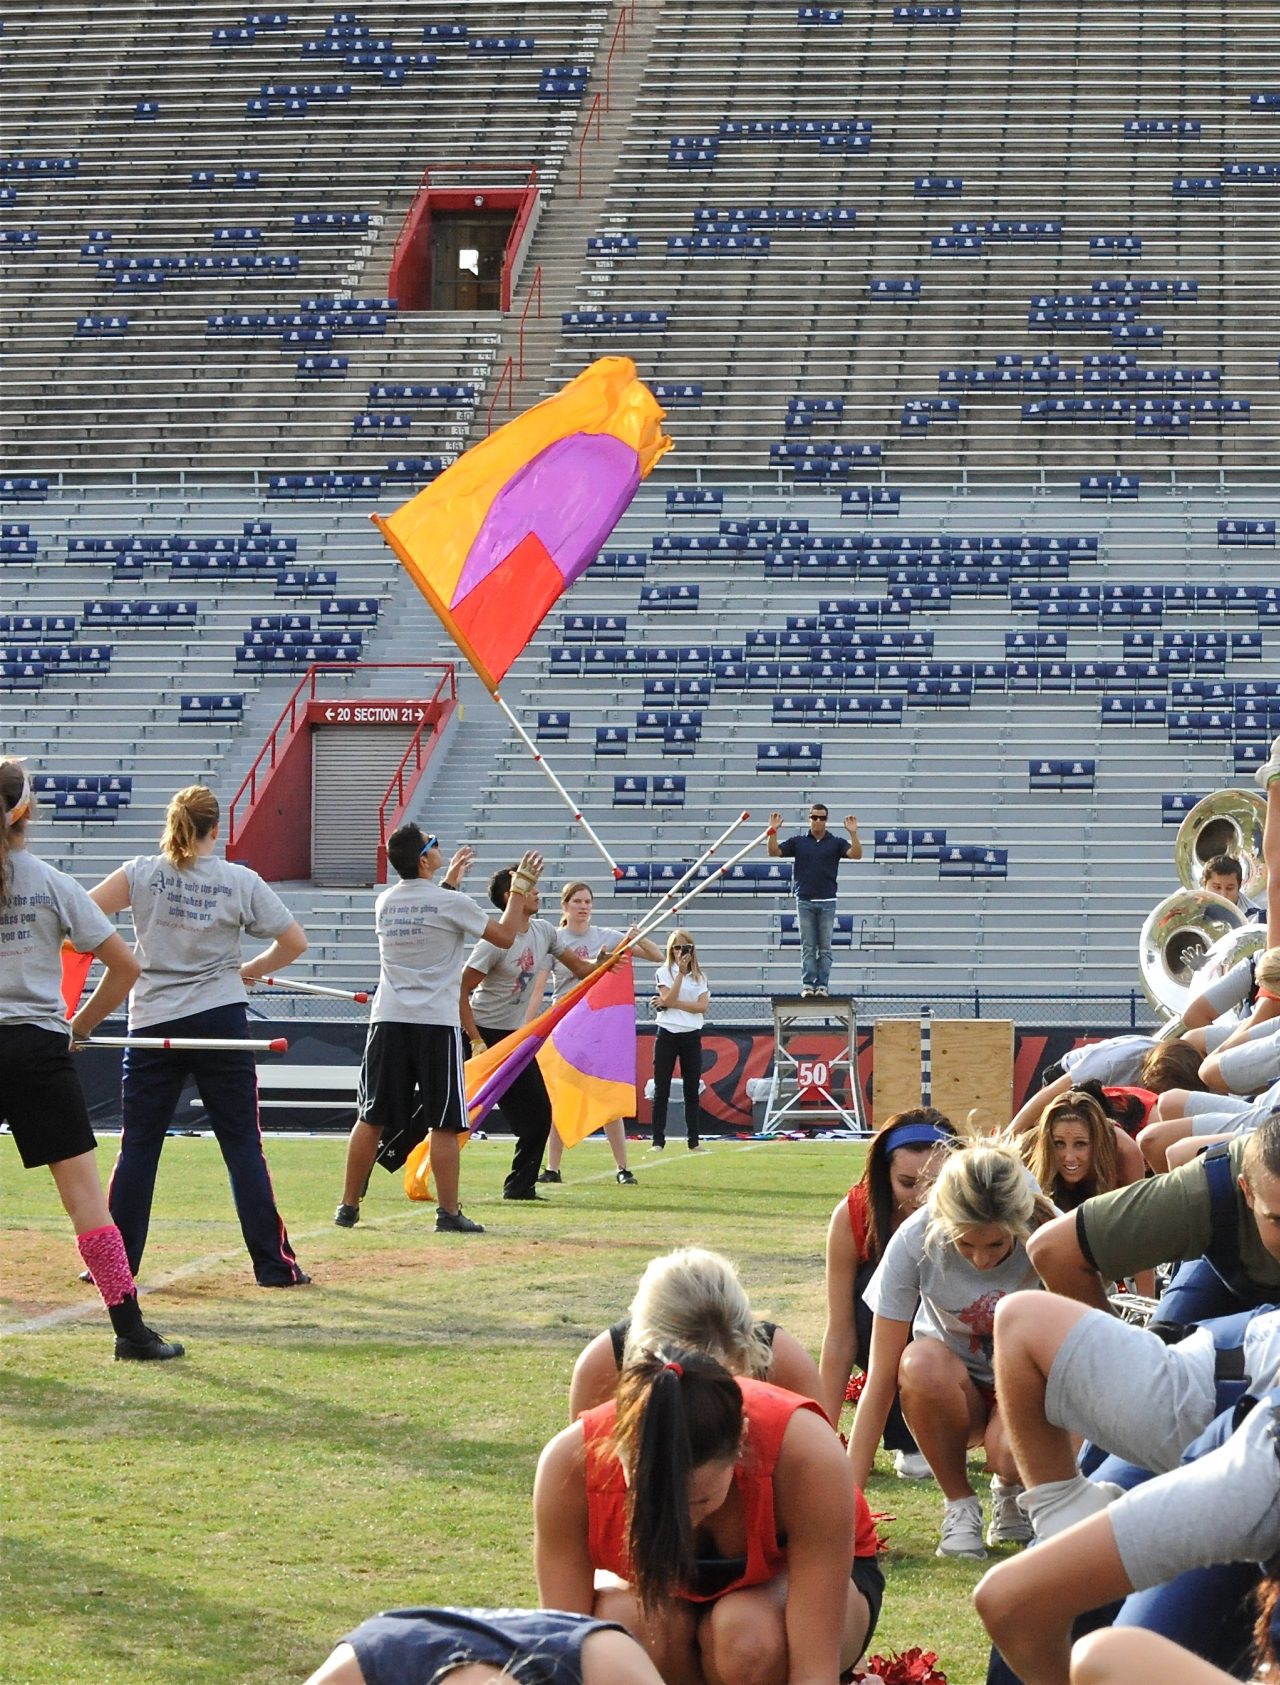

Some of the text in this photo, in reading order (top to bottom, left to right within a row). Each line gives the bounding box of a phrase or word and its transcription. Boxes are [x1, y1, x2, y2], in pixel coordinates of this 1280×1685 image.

[337, 708, 413, 721] 20 SECTION 21
[799, 1062, 827, 1086] 50
